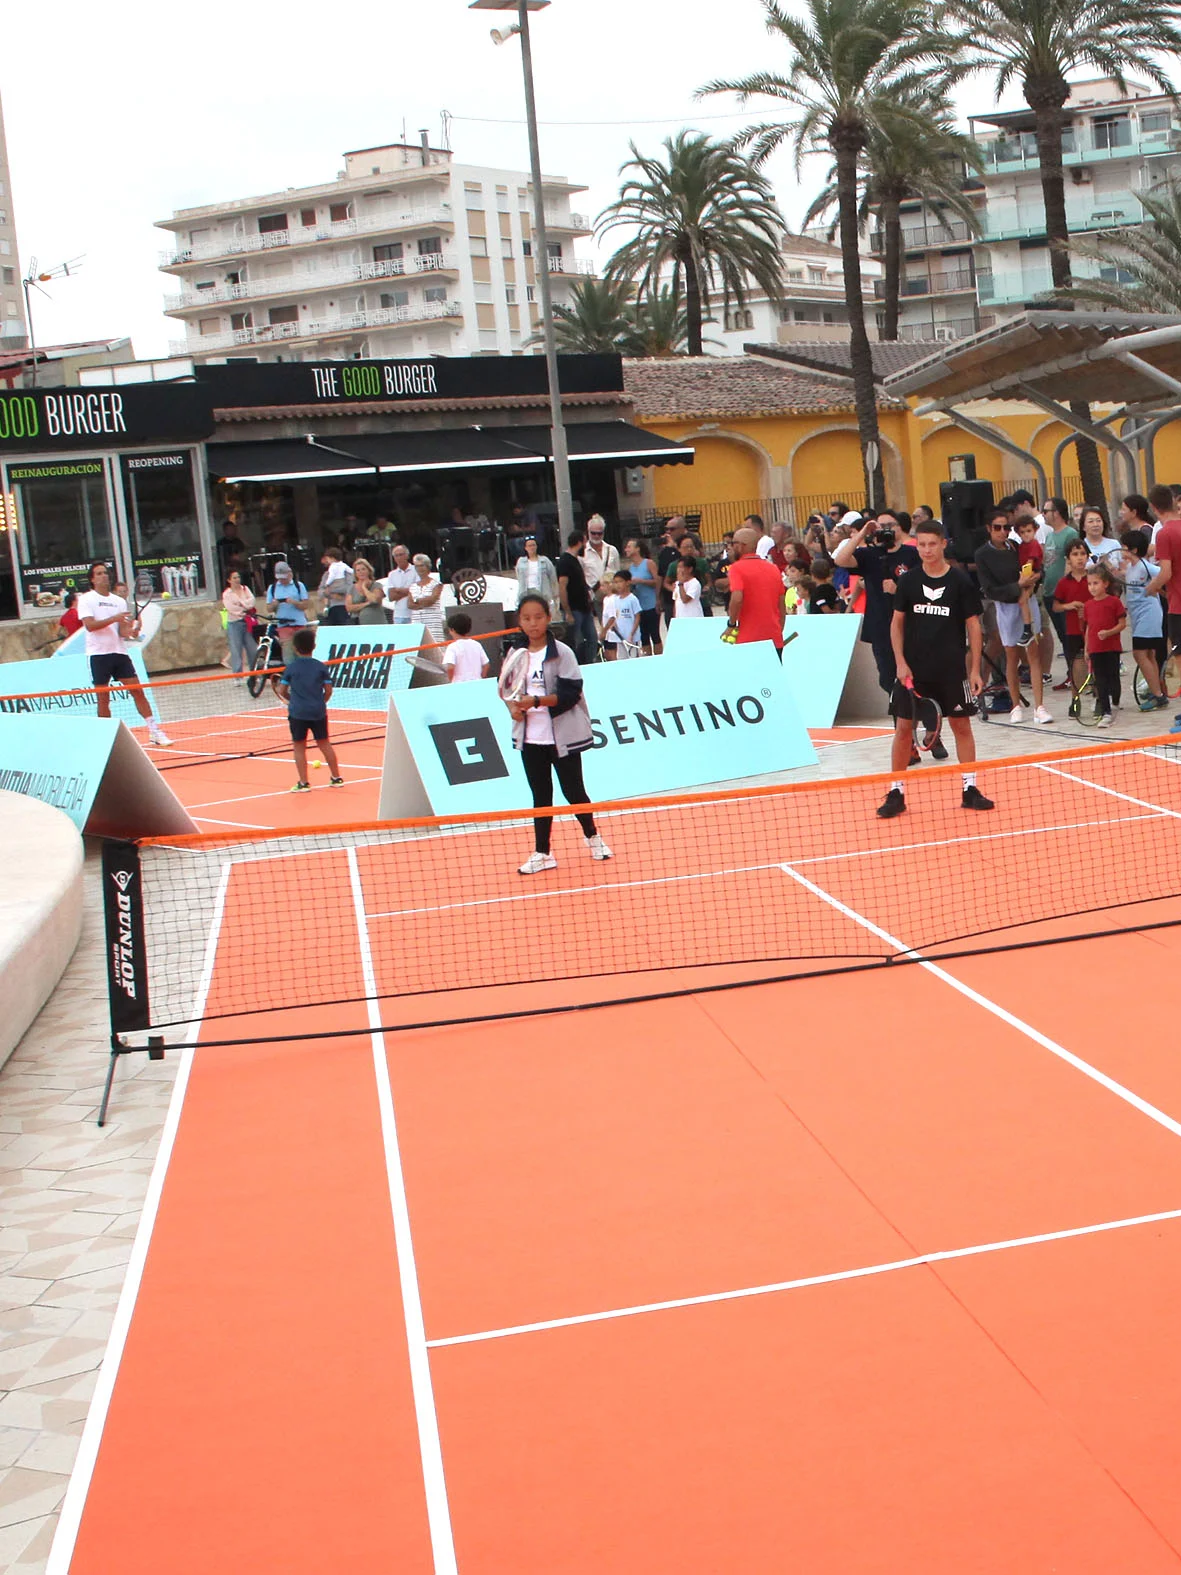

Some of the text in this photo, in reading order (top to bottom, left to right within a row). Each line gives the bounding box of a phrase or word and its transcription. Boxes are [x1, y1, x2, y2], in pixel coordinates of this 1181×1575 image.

[311, 364, 438, 398] THE GOOD BURGER
[44, 392, 127, 436] BURGER
[11, 463, 102, 479] REINAUGURACIÓN
[128, 455, 184, 469] REOPENING
[913, 602, 951, 617] erima
[325, 643, 395, 690] MARCA
[116, 891, 137, 1000] DUNLOP
